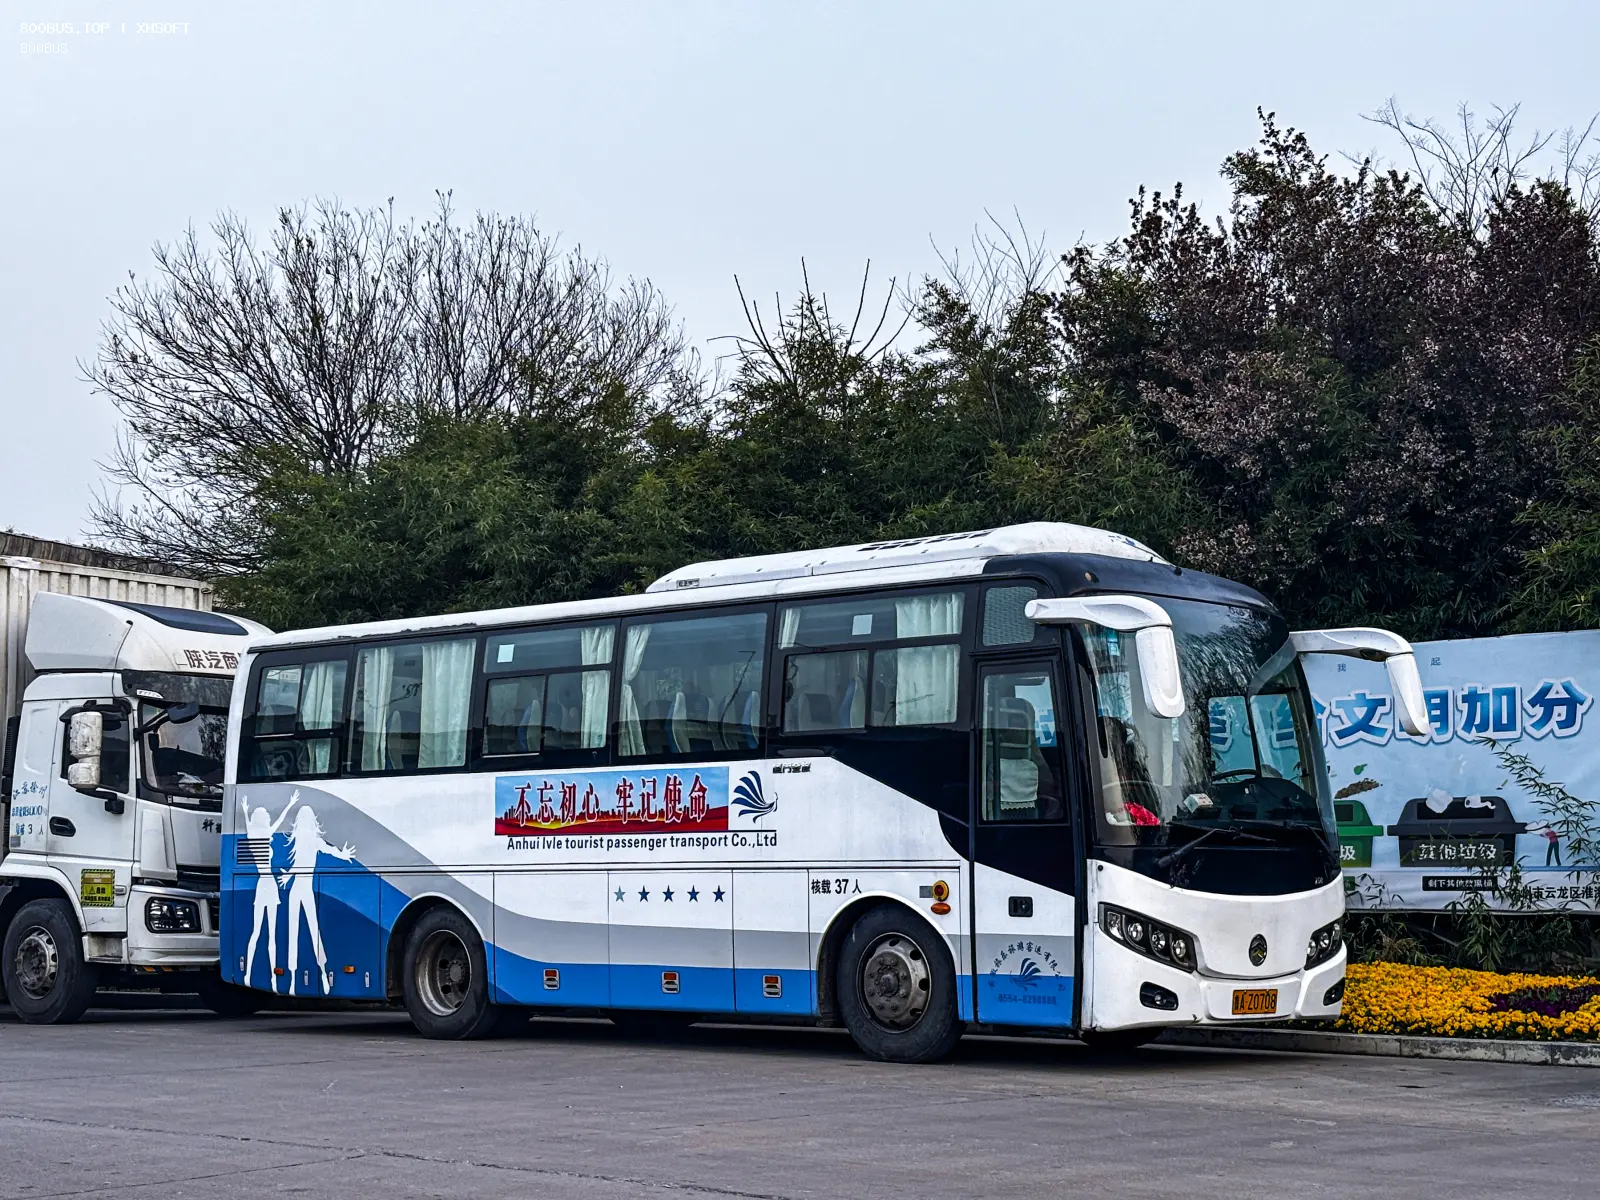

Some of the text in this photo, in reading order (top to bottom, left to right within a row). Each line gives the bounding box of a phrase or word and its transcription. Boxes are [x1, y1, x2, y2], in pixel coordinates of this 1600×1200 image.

[183, 649, 242, 670] 陕汽商
[513, 773, 709, 827] 不忘初心 牢记使命
[506, 836, 540, 850] Anhui
[564, 835, 604, 849] tourist
[606, 837, 668, 852] passenger
[669, 834, 729, 850] transport
[731, 832, 777, 848] Co.,Ltd
[1418, 842, 1497, 860] 其他垃圾
[811, 878, 862, 895] 核载 37 人
